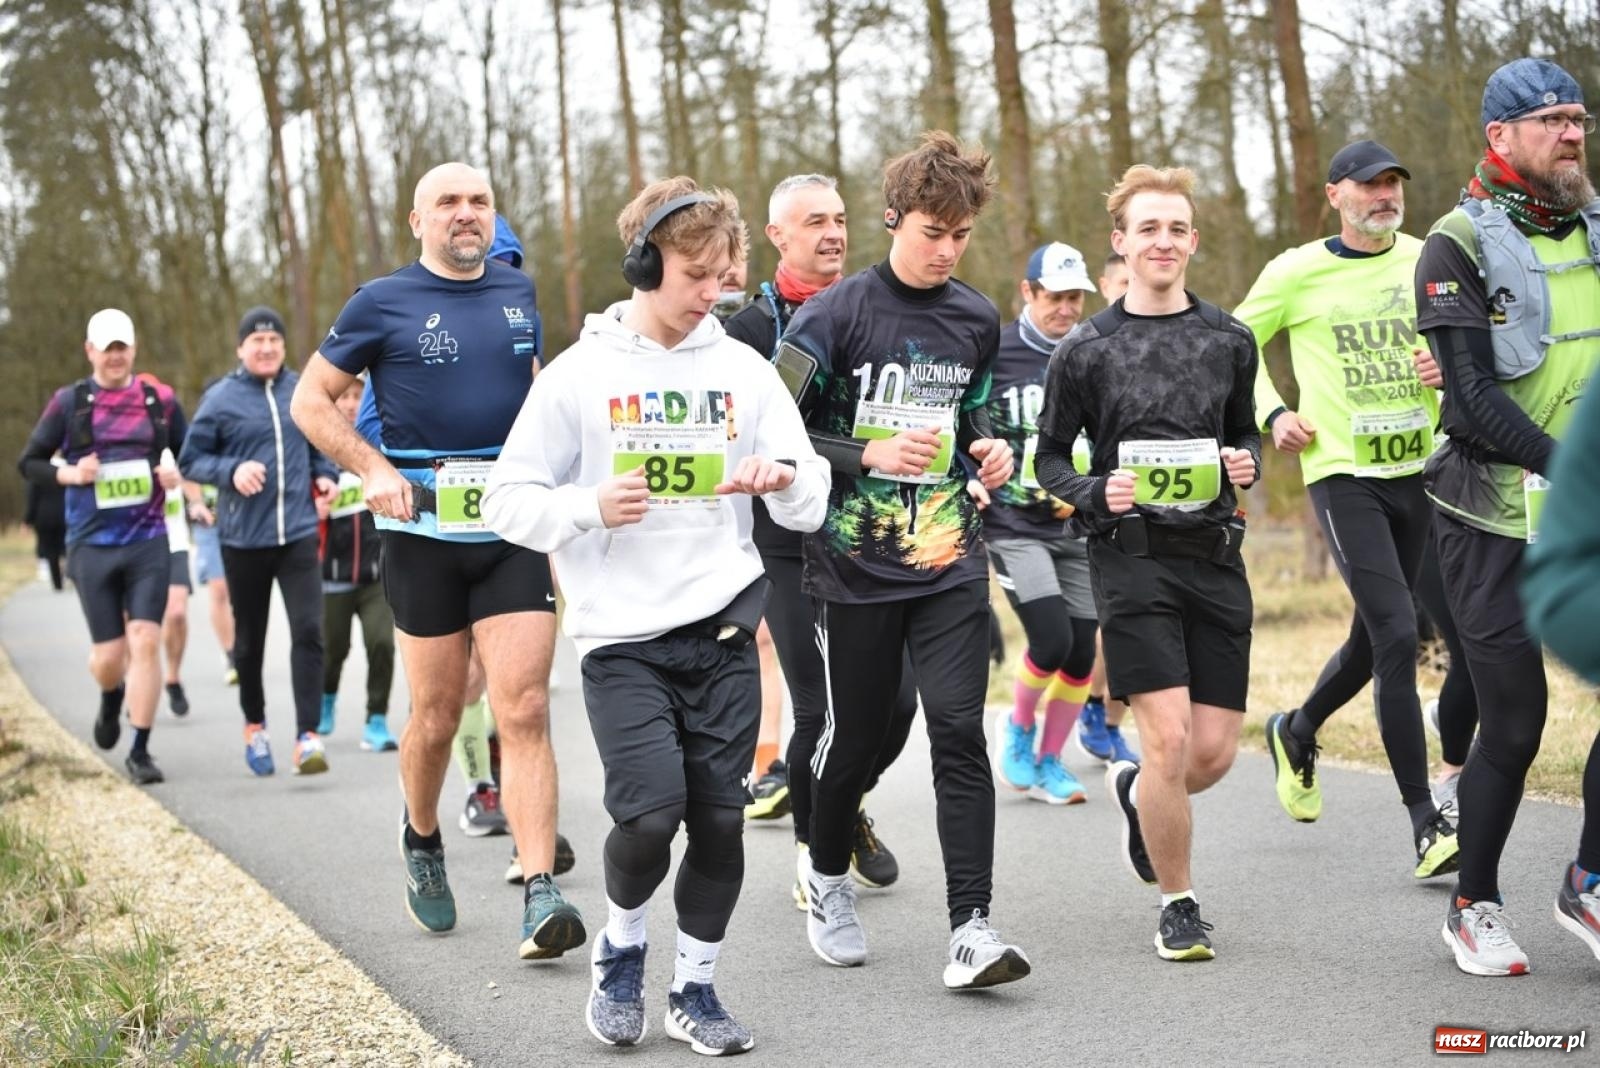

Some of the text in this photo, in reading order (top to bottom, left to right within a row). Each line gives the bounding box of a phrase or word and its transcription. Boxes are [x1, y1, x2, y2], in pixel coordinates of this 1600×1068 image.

[418, 330, 458, 357] 24
[1331, 317, 1418, 355] RUN
[1354, 347, 1407, 365] IN THE
[852, 362, 905, 404] 10
[1368, 430, 1424, 464] 104
[105, 478, 144, 498] 101
[644, 455, 695, 494] 85
[1148, 468, 1193, 500] 95
